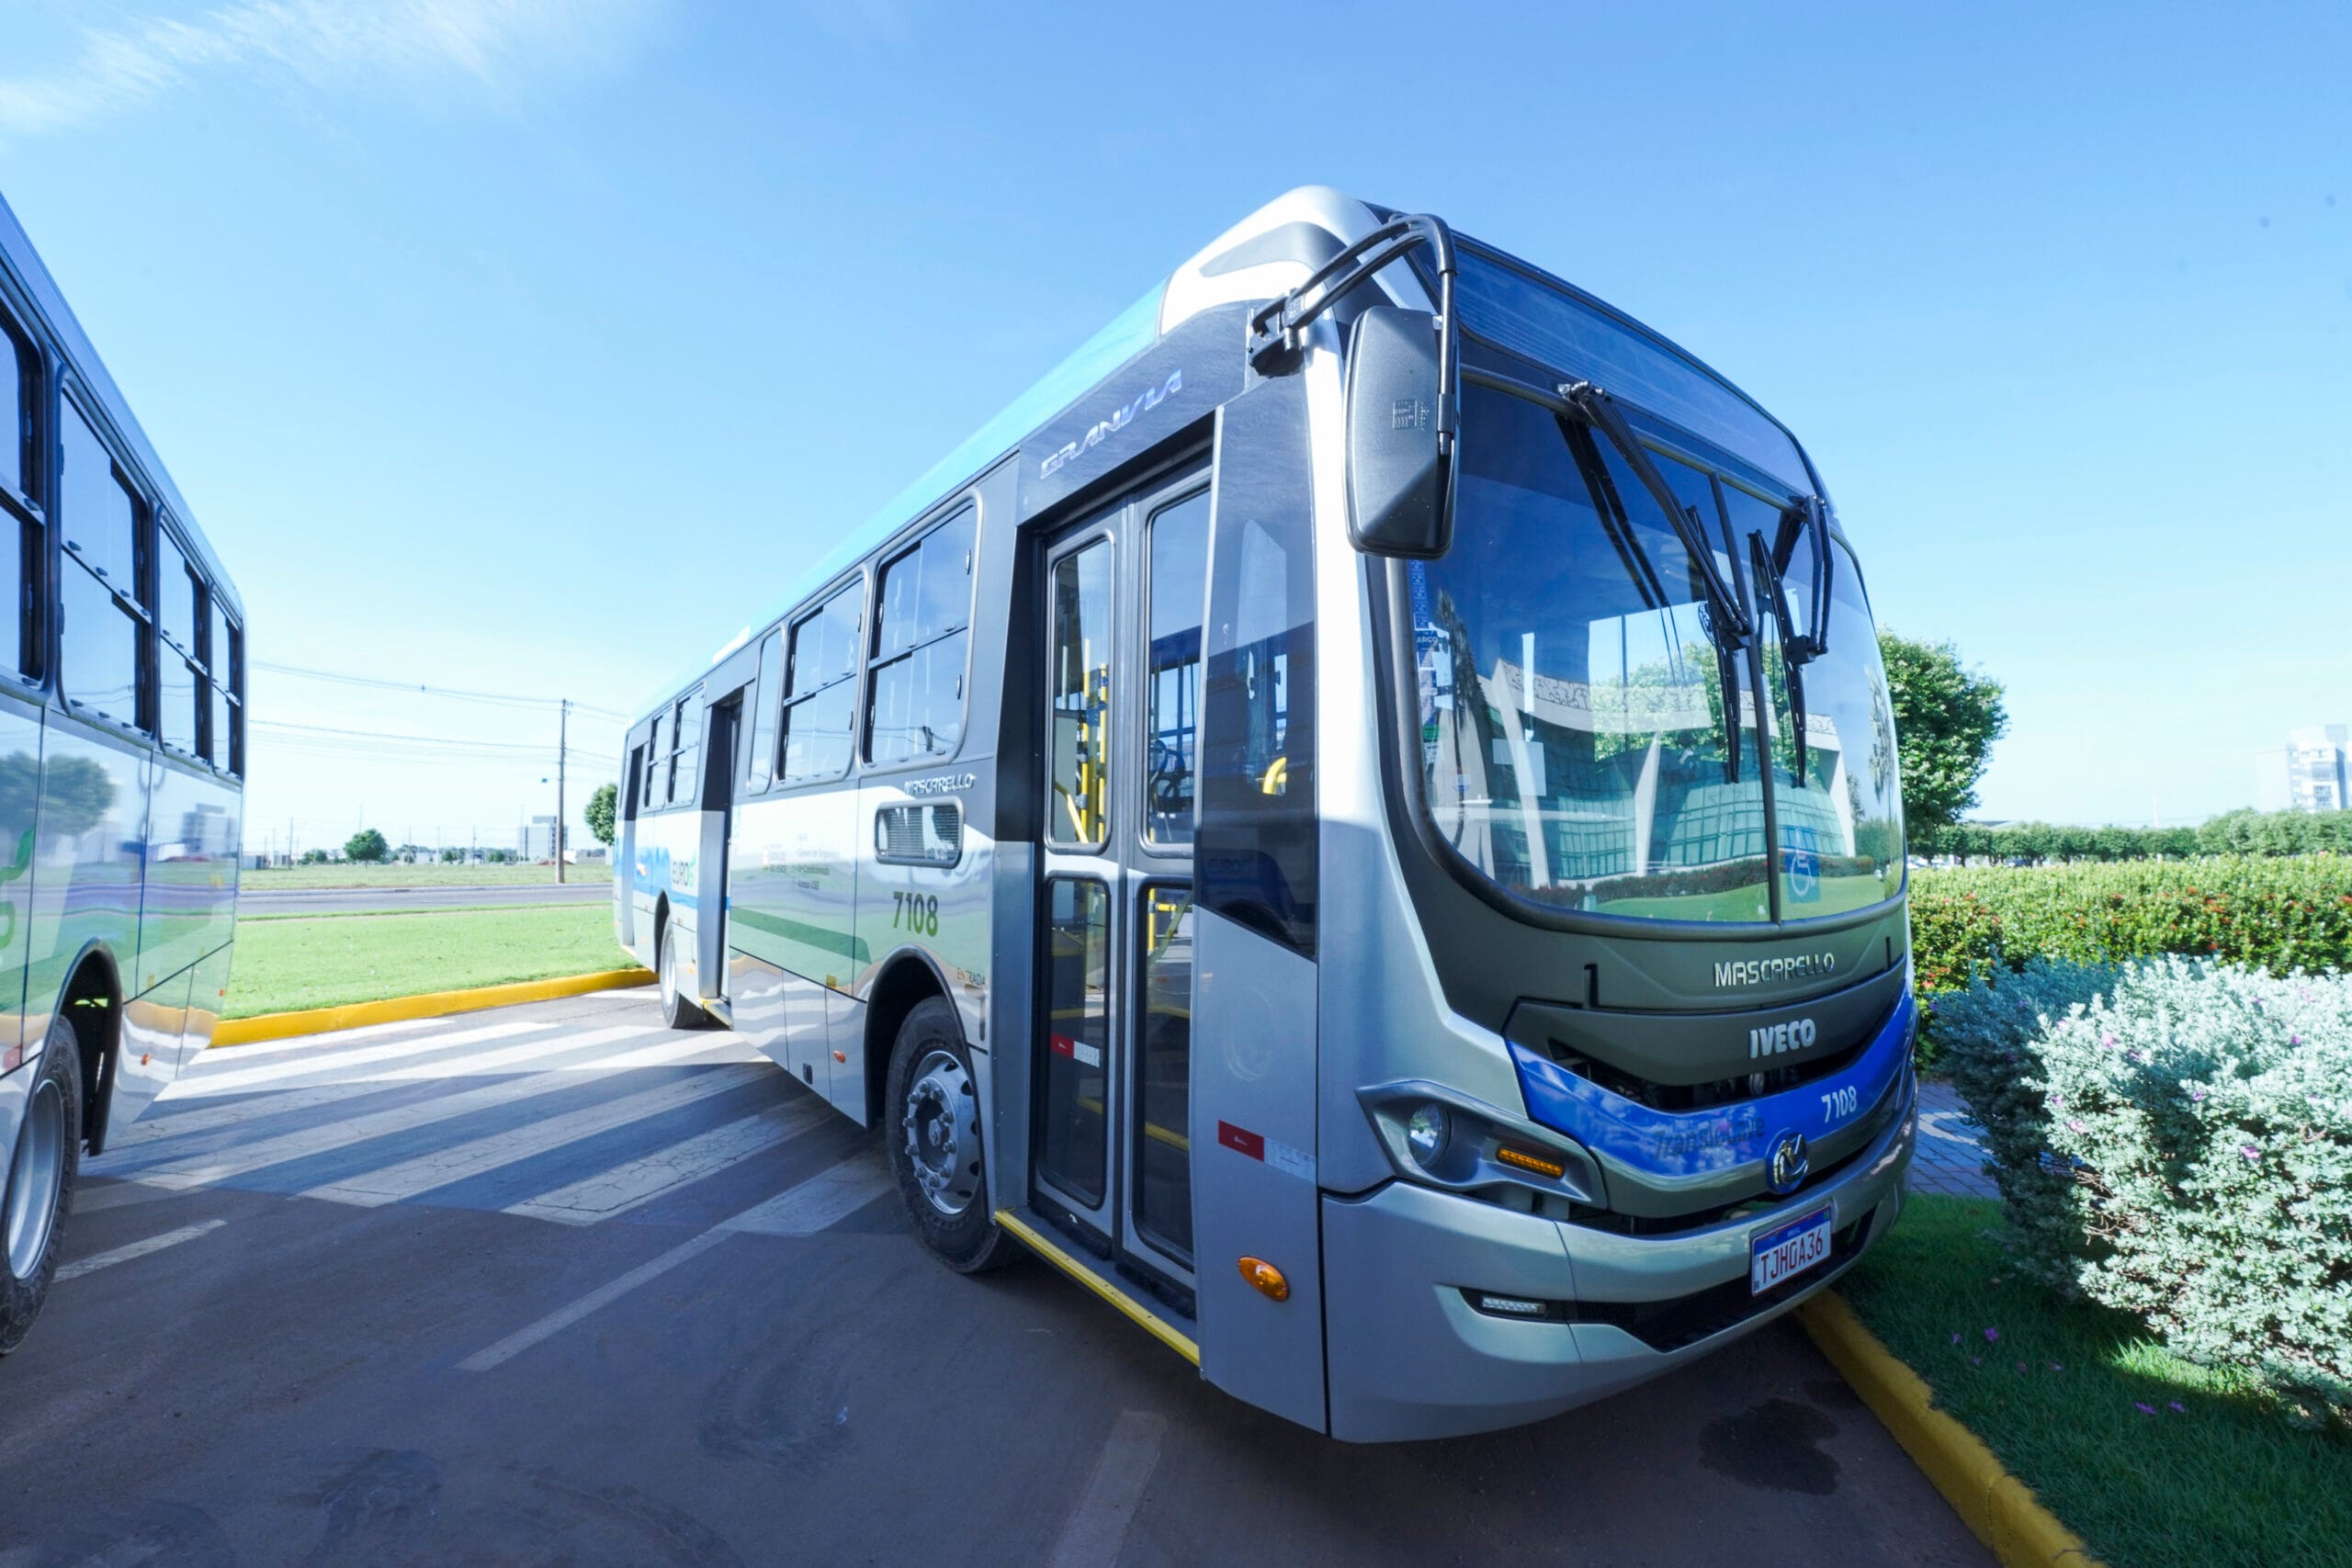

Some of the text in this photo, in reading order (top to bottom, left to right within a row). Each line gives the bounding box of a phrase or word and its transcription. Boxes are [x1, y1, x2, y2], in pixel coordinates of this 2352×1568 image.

[903, 773, 976, 795] MASCARELLO
[893, 891, 939, 937] 7108
[1714, 952, 1835, 987] MASCARELLO
[1749, 1018, 1817, 1059] IVECO
[1821, 1085, 1858, 1123] 7108
[1760, 1228, 1824, 1284] TJHGA36
